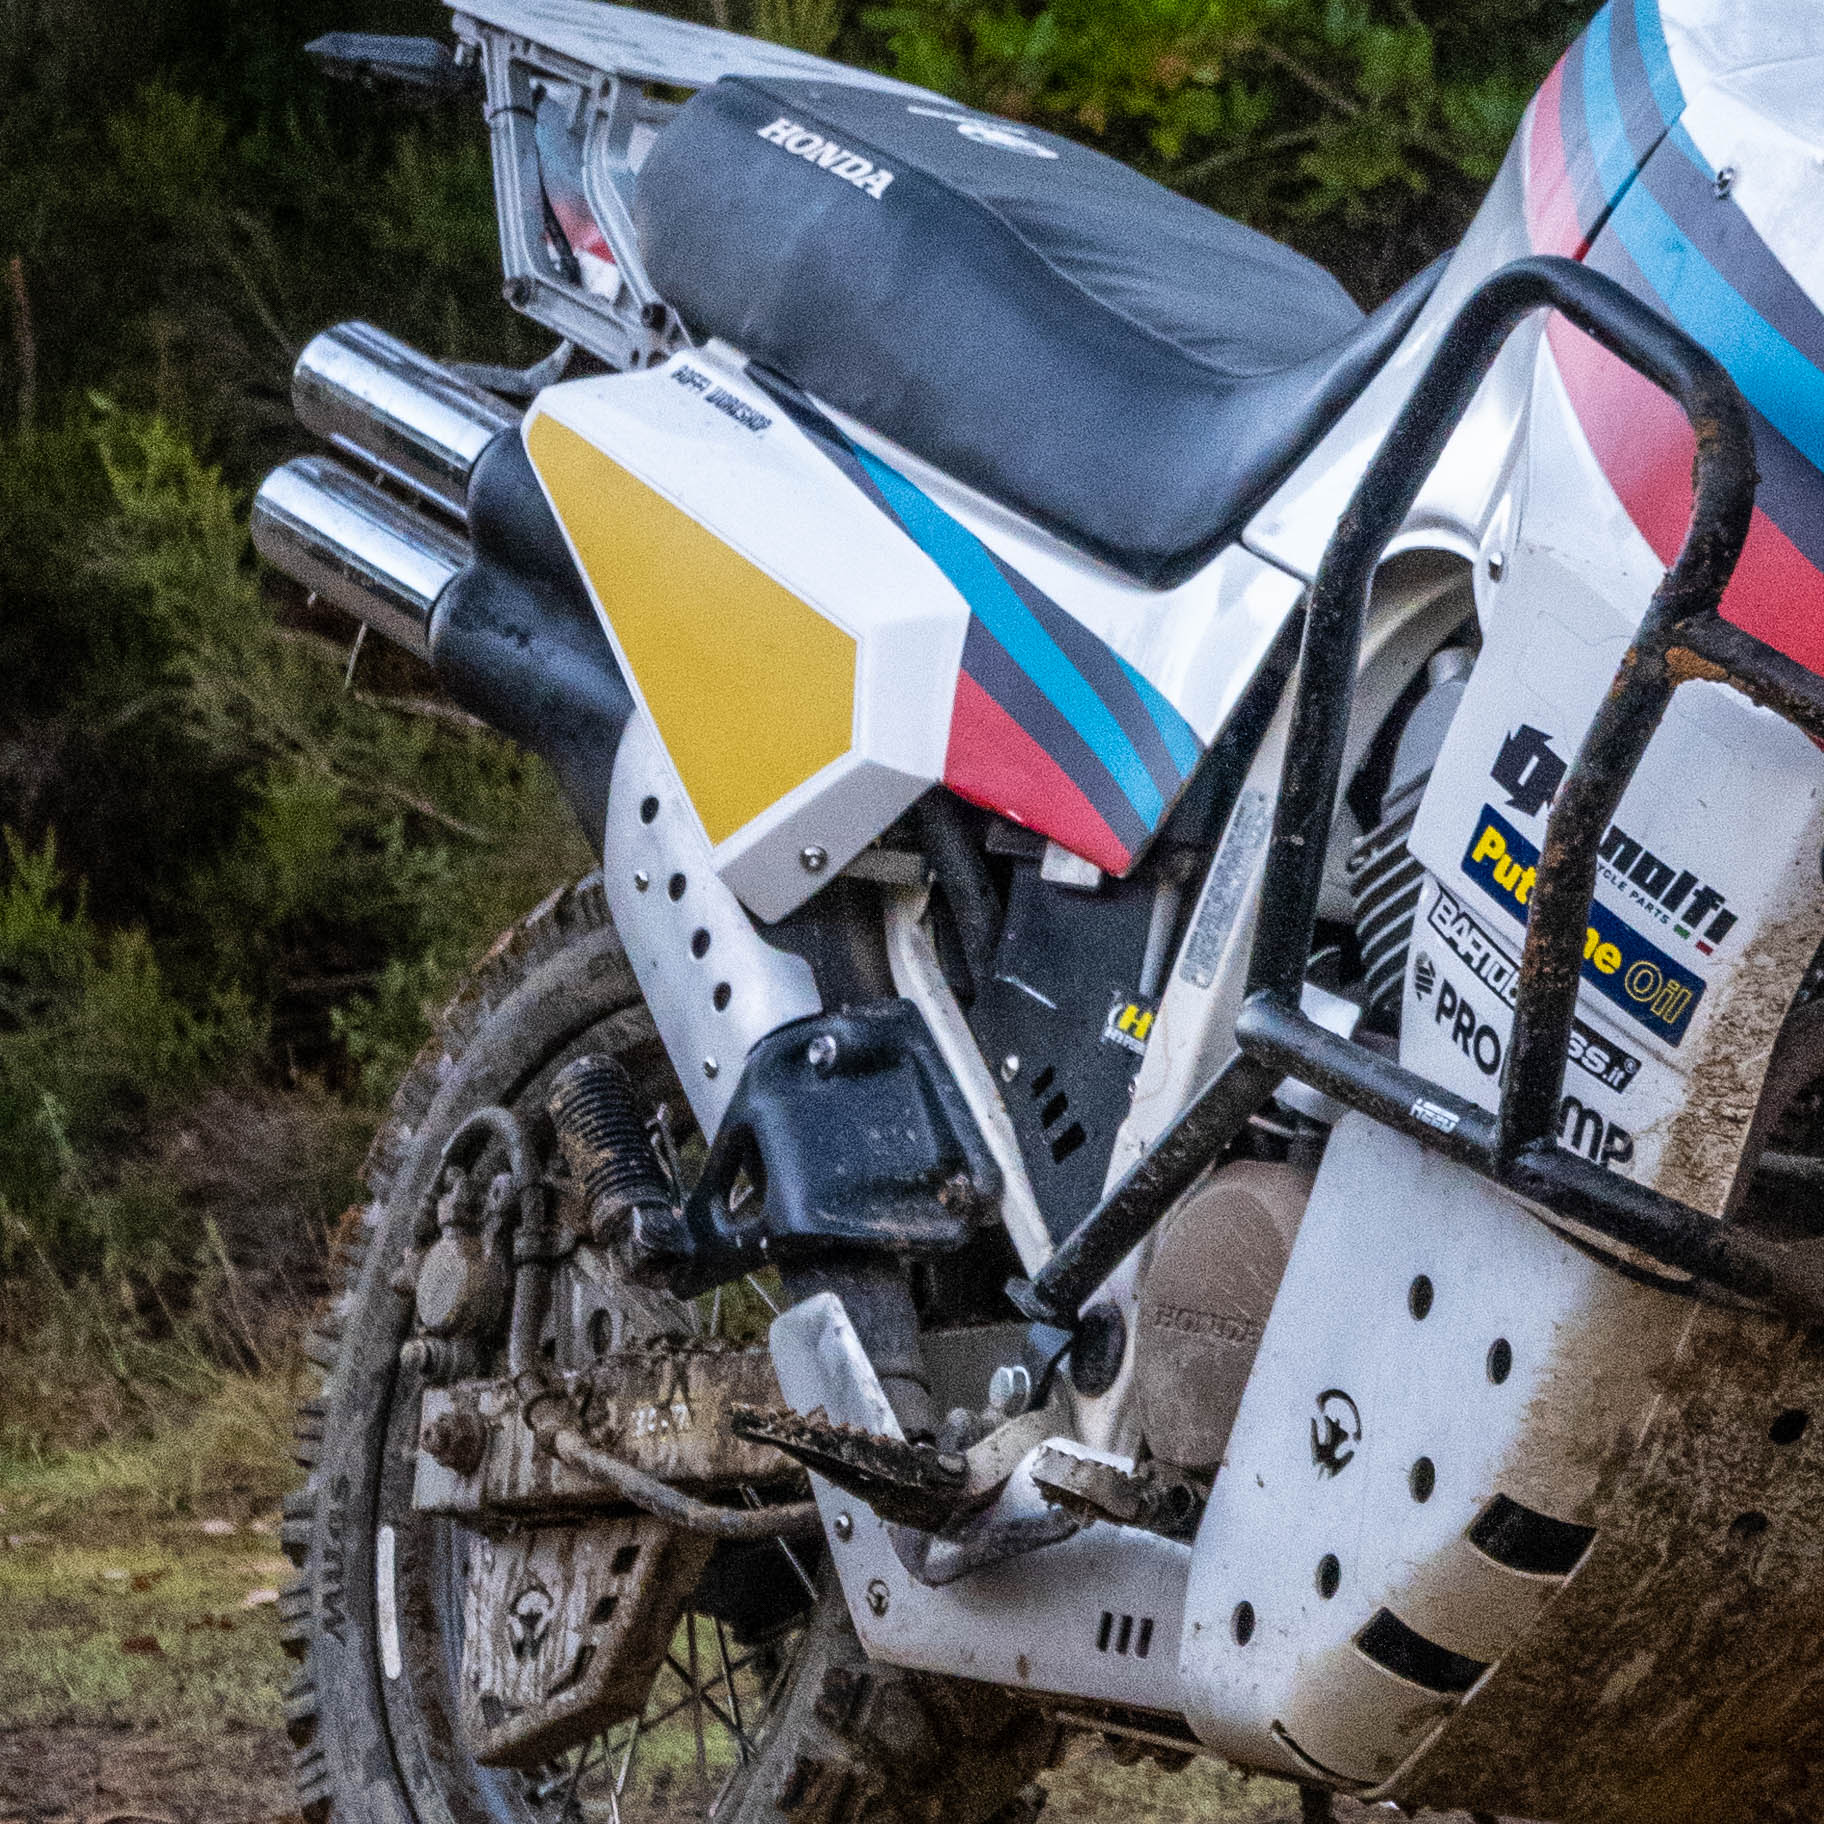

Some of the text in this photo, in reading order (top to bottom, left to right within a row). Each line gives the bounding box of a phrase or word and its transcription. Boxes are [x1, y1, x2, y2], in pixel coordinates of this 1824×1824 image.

[756, 116, 896, 201] HONDA
[1629, 889, 1672, 926] PARTS
[1624, 959, 1694, 1025] Oil
